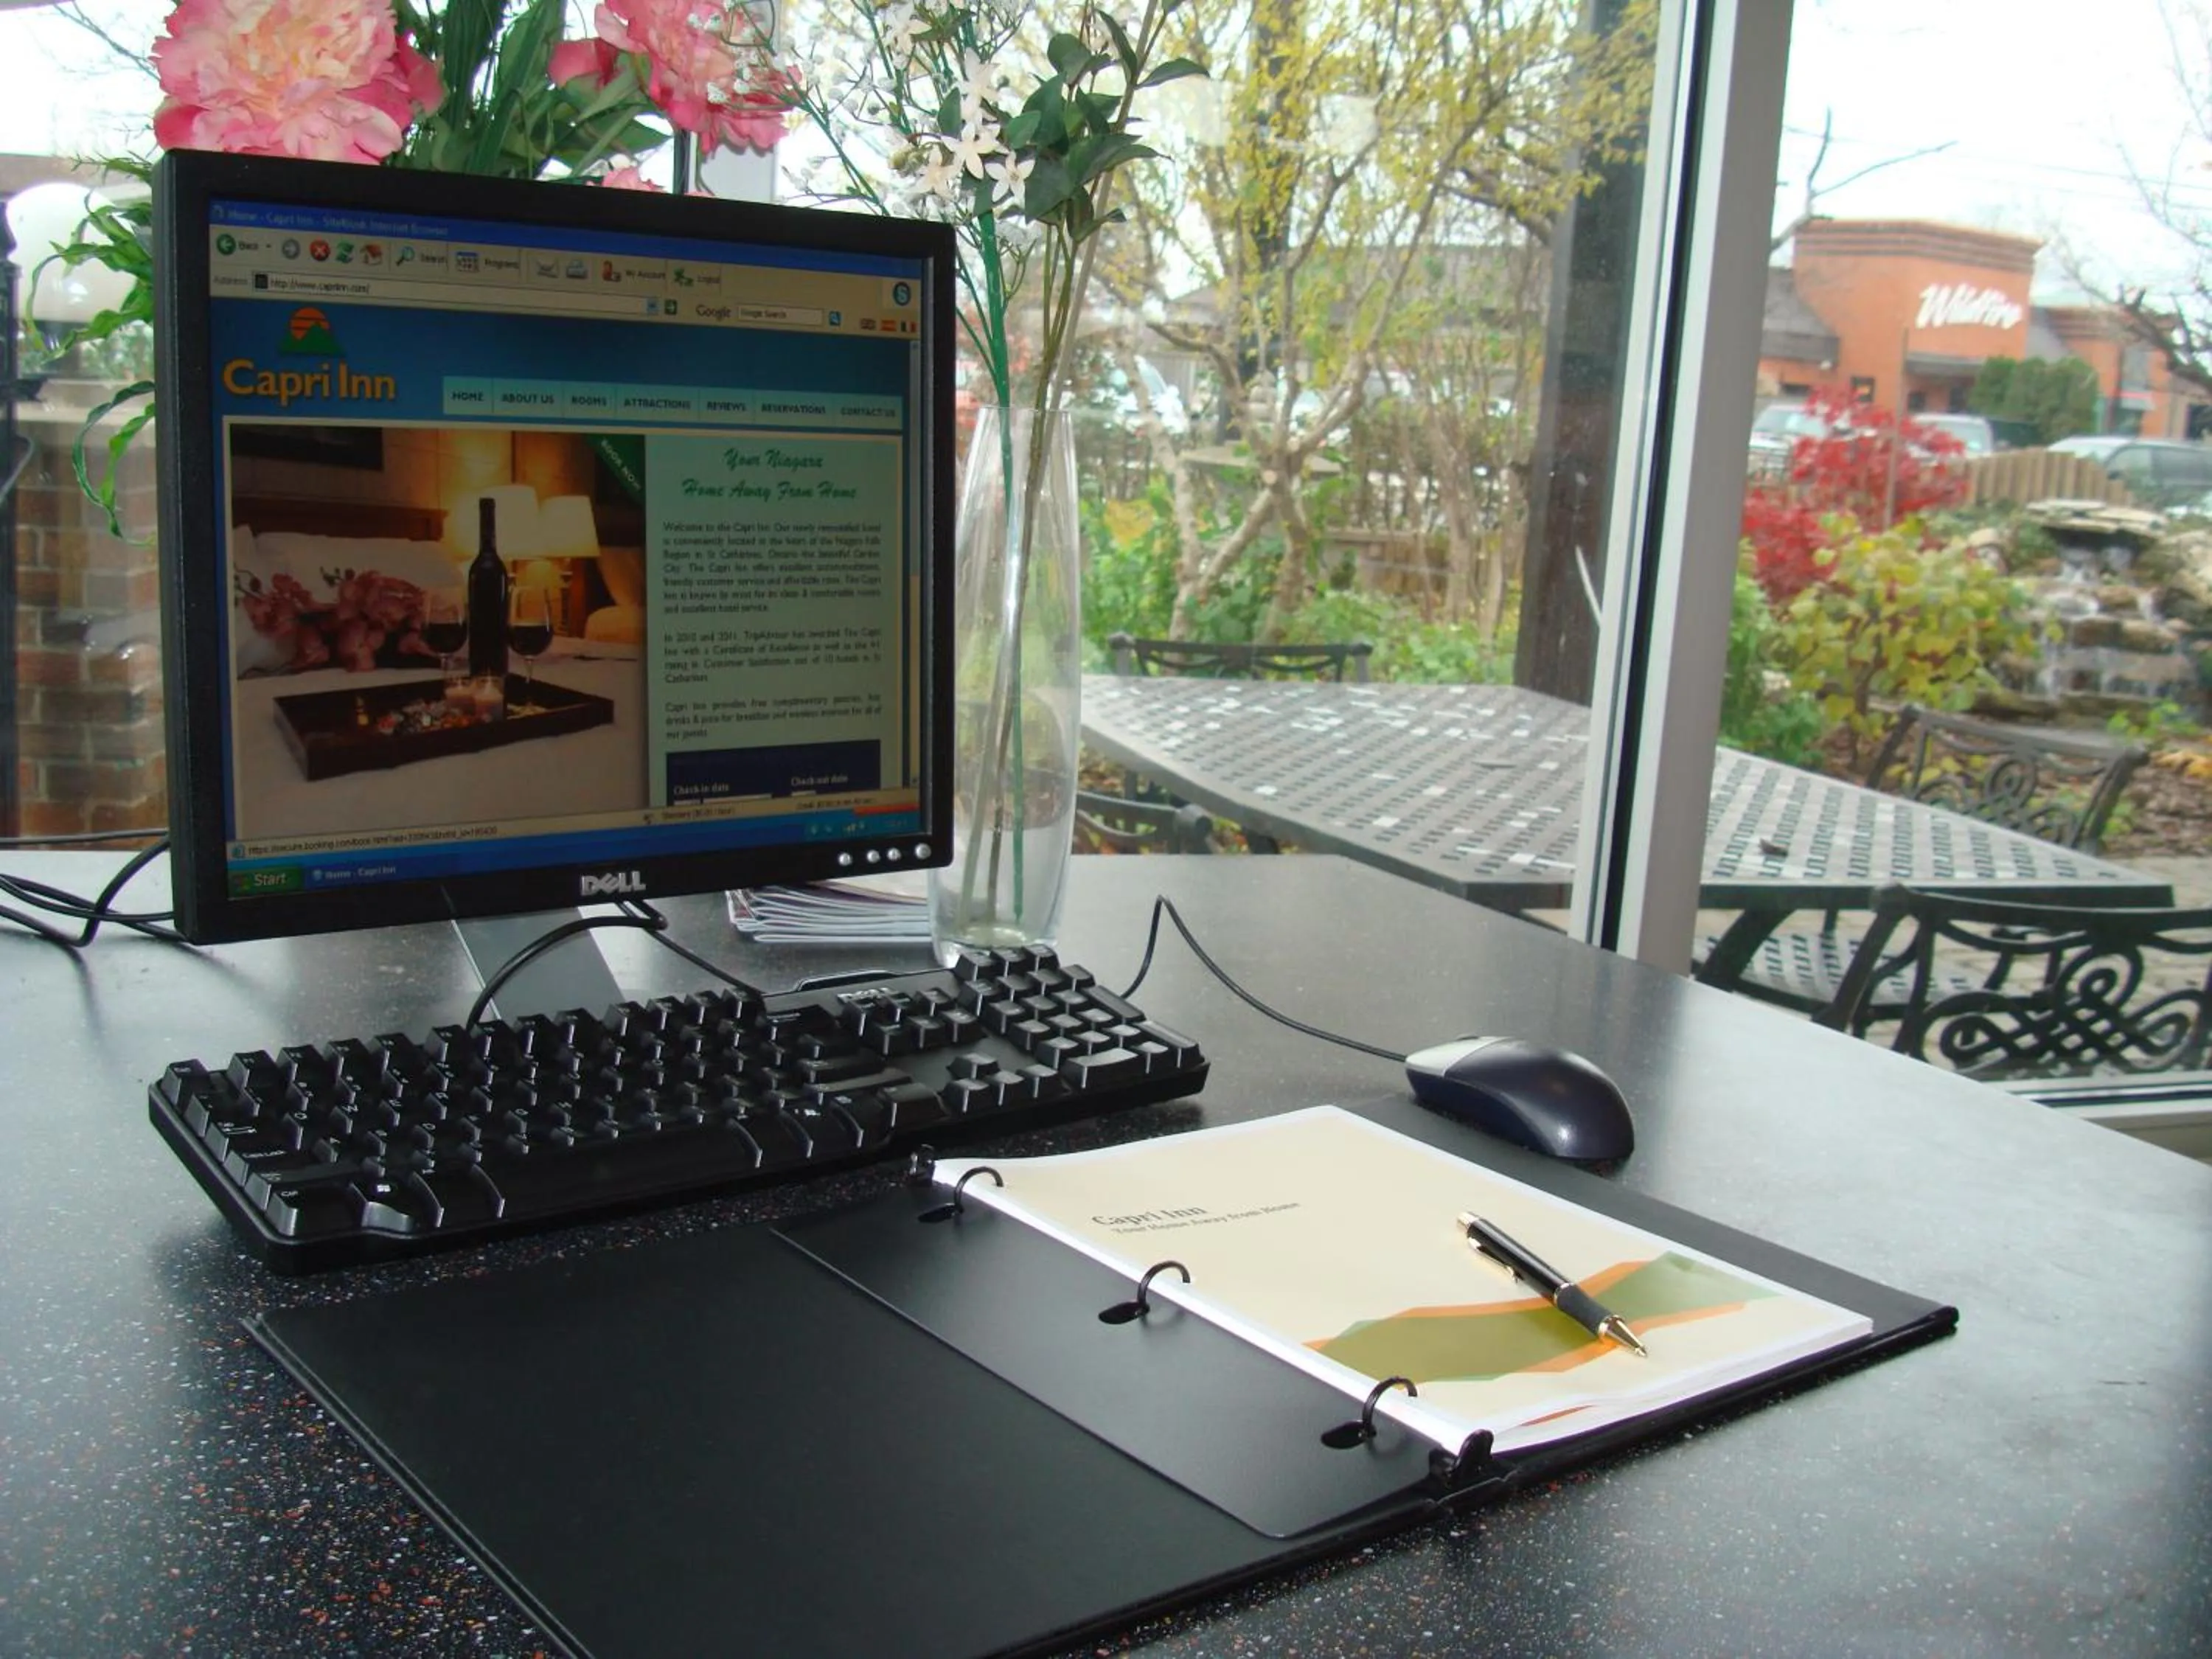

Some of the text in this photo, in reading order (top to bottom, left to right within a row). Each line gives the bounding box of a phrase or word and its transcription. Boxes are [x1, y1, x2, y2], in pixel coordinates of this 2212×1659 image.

[696, 305, 732, 321] Google
[223, 358, 397, 408] Capri Inn
[452, 391, 485, 403] HOME
[501, 393, 555, 405] ABOUT US
[571, 395, 608, 407] ROOMS
[624, 397, 692, 411] ATTRACTIONS
[707, 400, 746, 412] REVIEWS
[761, 403, 827, 414] RESERVATIONS
[253, 872, 288, 887] Start
[581, 869, 647, 897] DELL
[1091, 1206, 1208, 1225] Capri Inn
[1110, 1225, 1147, 1235] Your
[1146, 1221, 1191, 1231] Home
[1189, 1217, 1228, 1227] Away
[1259, 1202, 1301, 1214] Home
